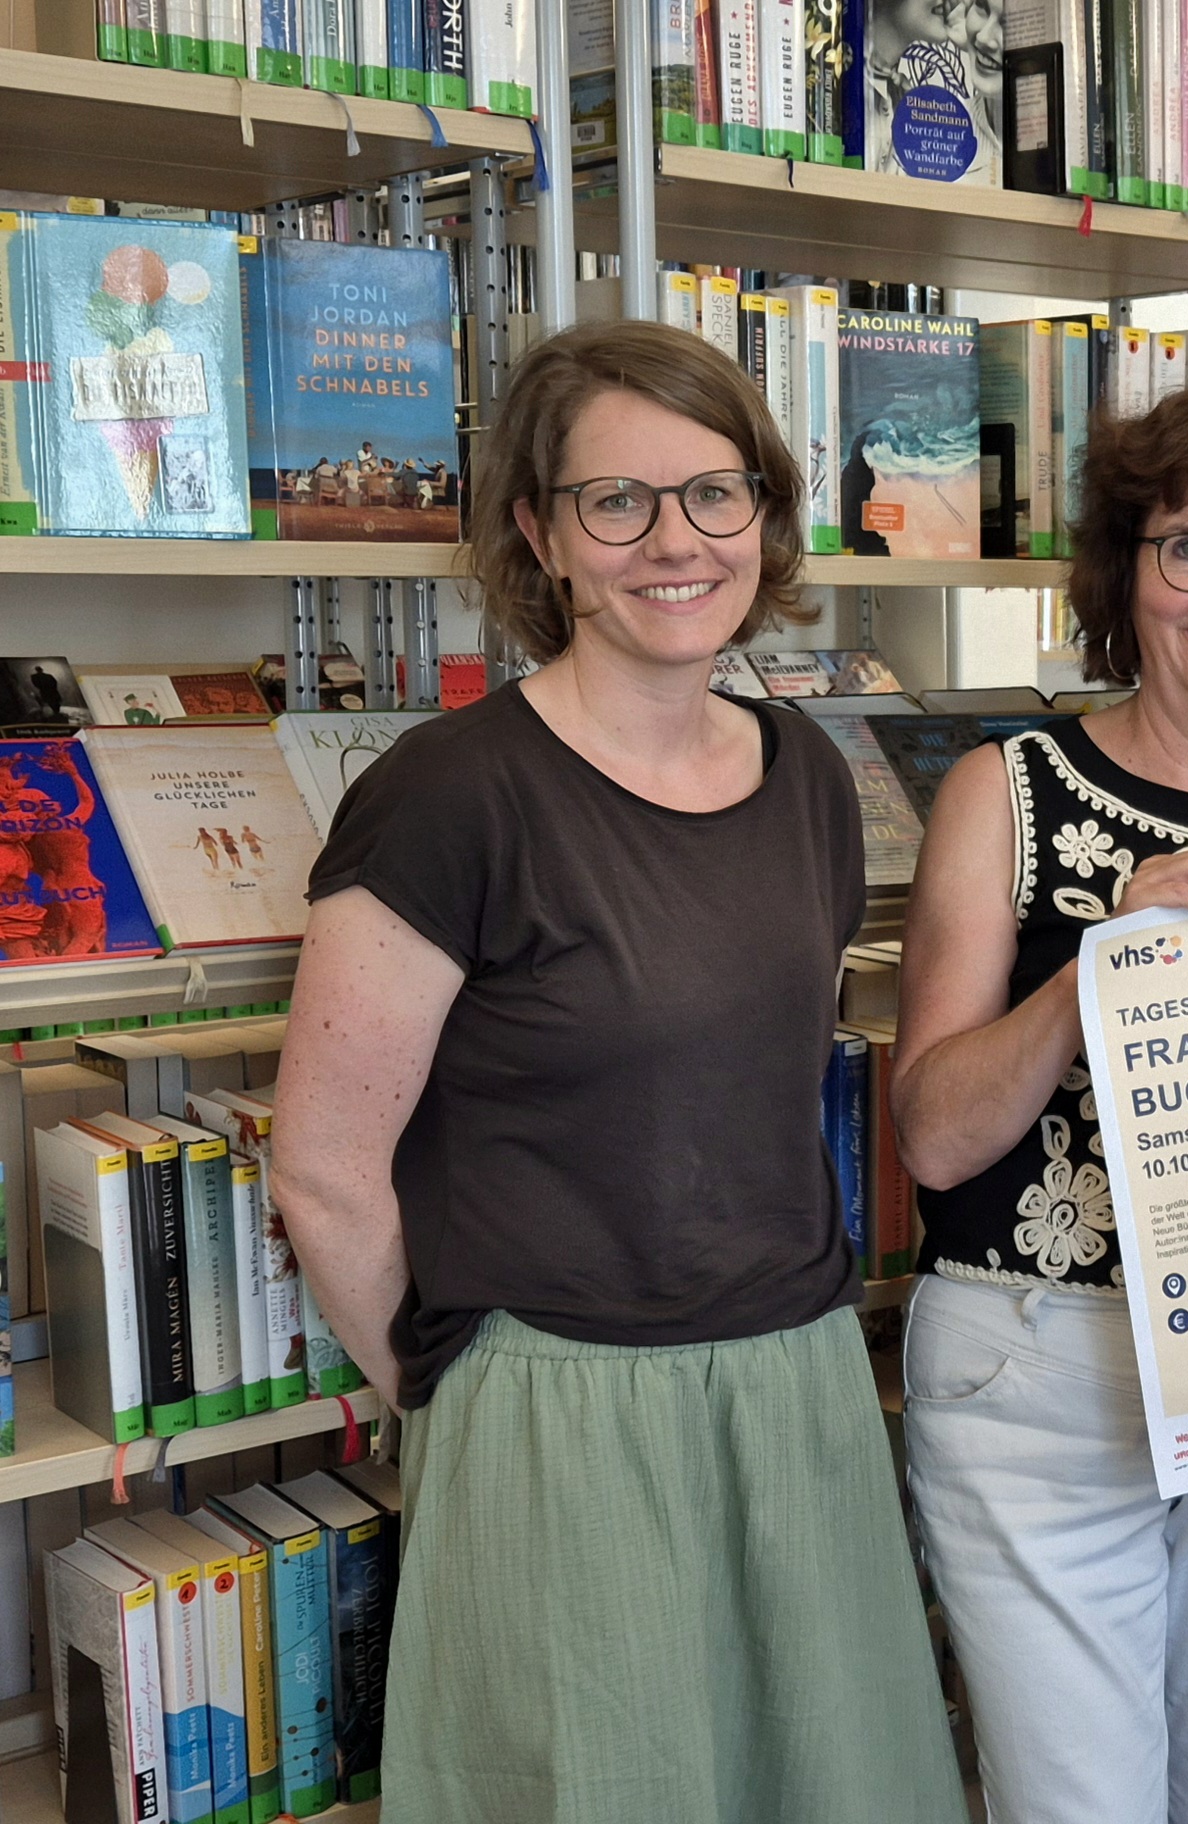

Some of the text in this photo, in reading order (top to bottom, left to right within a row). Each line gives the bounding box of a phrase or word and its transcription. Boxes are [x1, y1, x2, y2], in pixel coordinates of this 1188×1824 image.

[729, 31, 744, 123] EUGEN RUGE
[782, 36, 794, 118] EUGEN RUGE
[906, 95, 956, 113] Elisabeth
[911, 109, 969, 127] Sandmann
[904, 122, 966, 141] Porträt auf
[1124, 111, 1136, 154] ELLEN
[920, 139, 959, 153] grüner
[903, 149, 964, 167] Wandfarbe
[917, 166, 947, 176] ROMAN
[328, 283, 387, 303] TONI
[310, 305, 407, 327] JORDAN
[711, 294, 723, 343] SPECK
[722, 294, 734, 347] DANIEL
[837, 314, 975, 338] CAROLINE WAHL
[315, 328, 407, 350] DINNER
[838, 334, 975, 356] WINDSTÄRKE 17
[312, 352, 412, 373] MIT DEN
[296, 374, 430, 398] SCHNABELS
[779, 344, 788, 423] DIE JAHRE
[1037, 450, 1048, 491] TRUDE
[753, 654, 781, 665] LIAM
[150, 770, 245, 781] JULIA HOLBE
[173, 780, 230, 790] UNSERE
[153, 790, 257, 801] GLÜCKLICHEN
[191, 800, 229, 810] TAGE
[1109, 944, 1156, 971] vhs
[1148, 1204, 1163, 1214] Die
[1151, 1216, 1165, 1226] der
[1166, 1211, 1185, 1222] Welt
[1152, 1226, 1175, 1236] Neue
[161, 1160, 184, 1383] MIRA MAGÉN ZUVERSICHT
[251, 1280, 260, 1298] Ian
[269, 1288, 280, 1335] ANNETTE
[277, 1287, 288, 1333] MINGELS
[214, 1303, 225, 1376] INGER-MARIA
[219, 1577, 229, 1589] 2
[361, 1555, 380, 1608] JODI
[295, 1651, 310, 1685] JODI
[310, 1635, 322, 1694] PICOULT
[252, 1604, 270, 1762] Ein anderes Leben Caroline
[186, 1712, 199, 1781] Monika Peetz
[225, 1722, 236, 1789] Monika Peetz
[141, 1771, 157, 1817] PIPER
